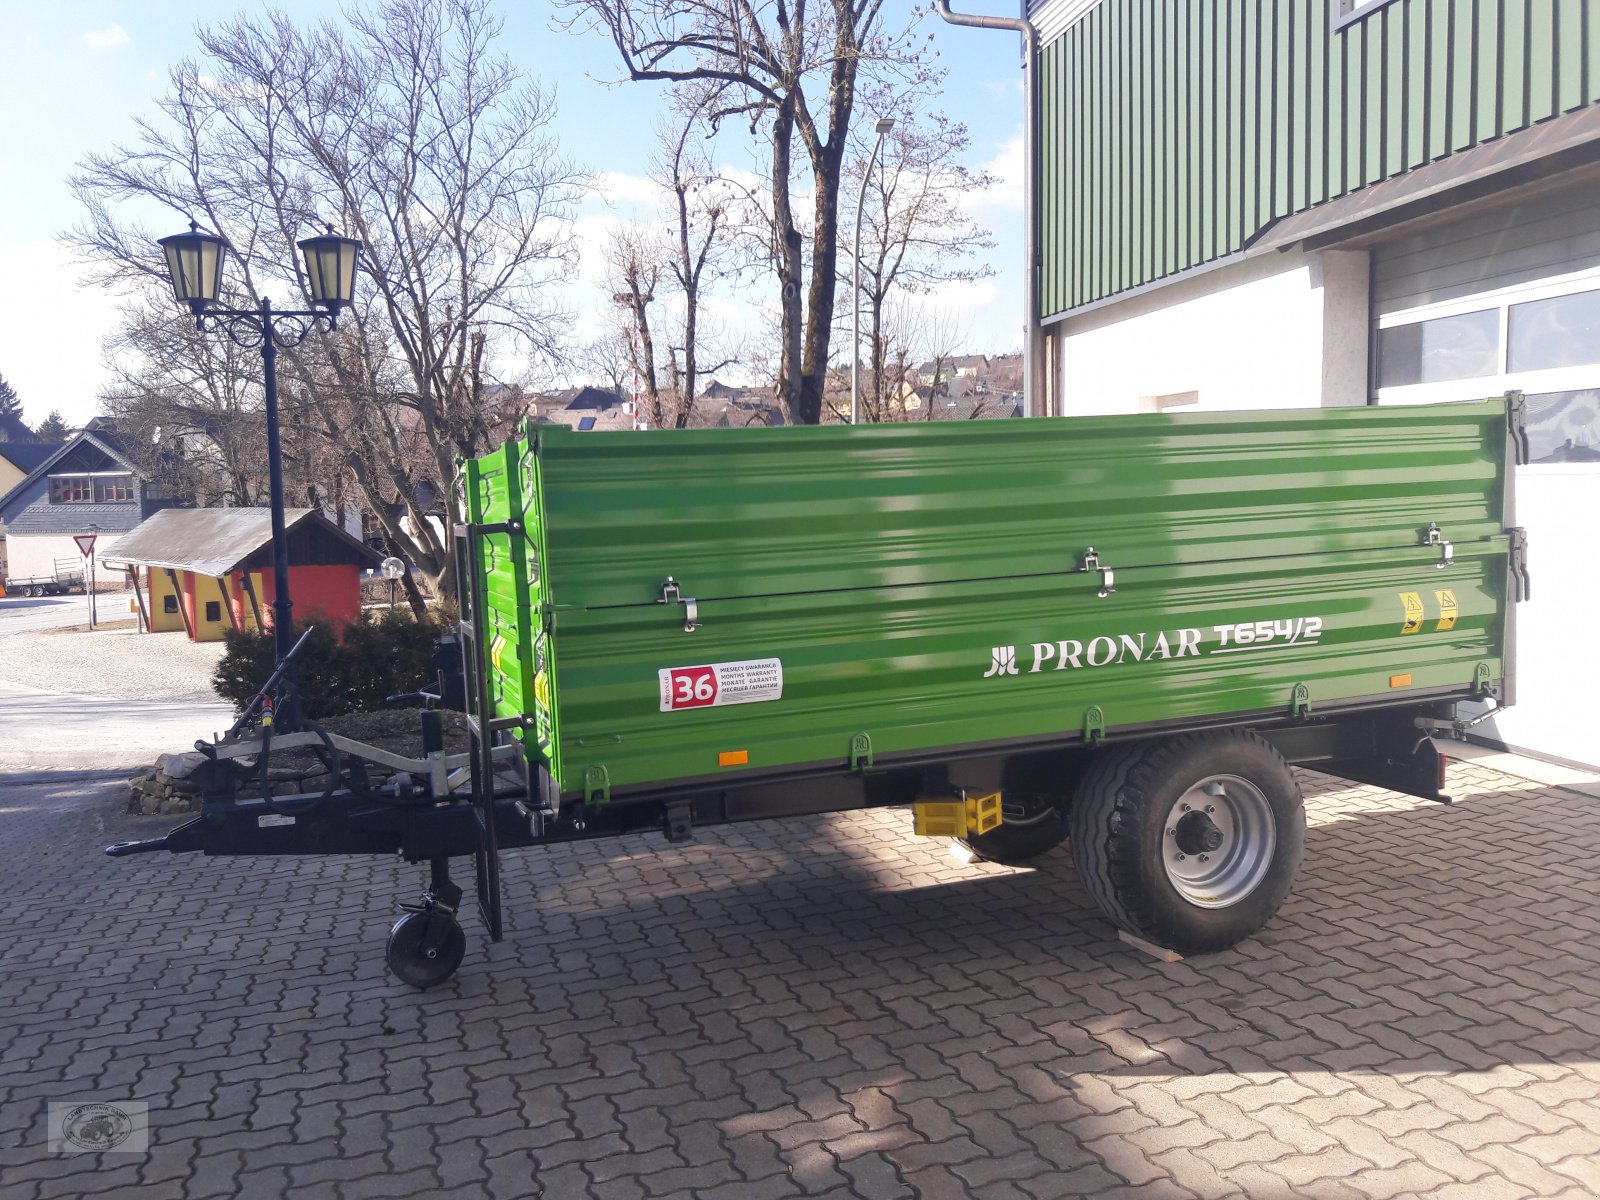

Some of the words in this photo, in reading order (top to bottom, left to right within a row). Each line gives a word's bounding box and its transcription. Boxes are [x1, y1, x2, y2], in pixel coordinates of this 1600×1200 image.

[1028, 628, 1201, 673] PRONAR
[1213, 616, 1323, 646] T654/2
[721, 672, 745, 680] MONTHS
[721, 679, 745, 687] MONATE
[675, 673, 714, 703] 36
